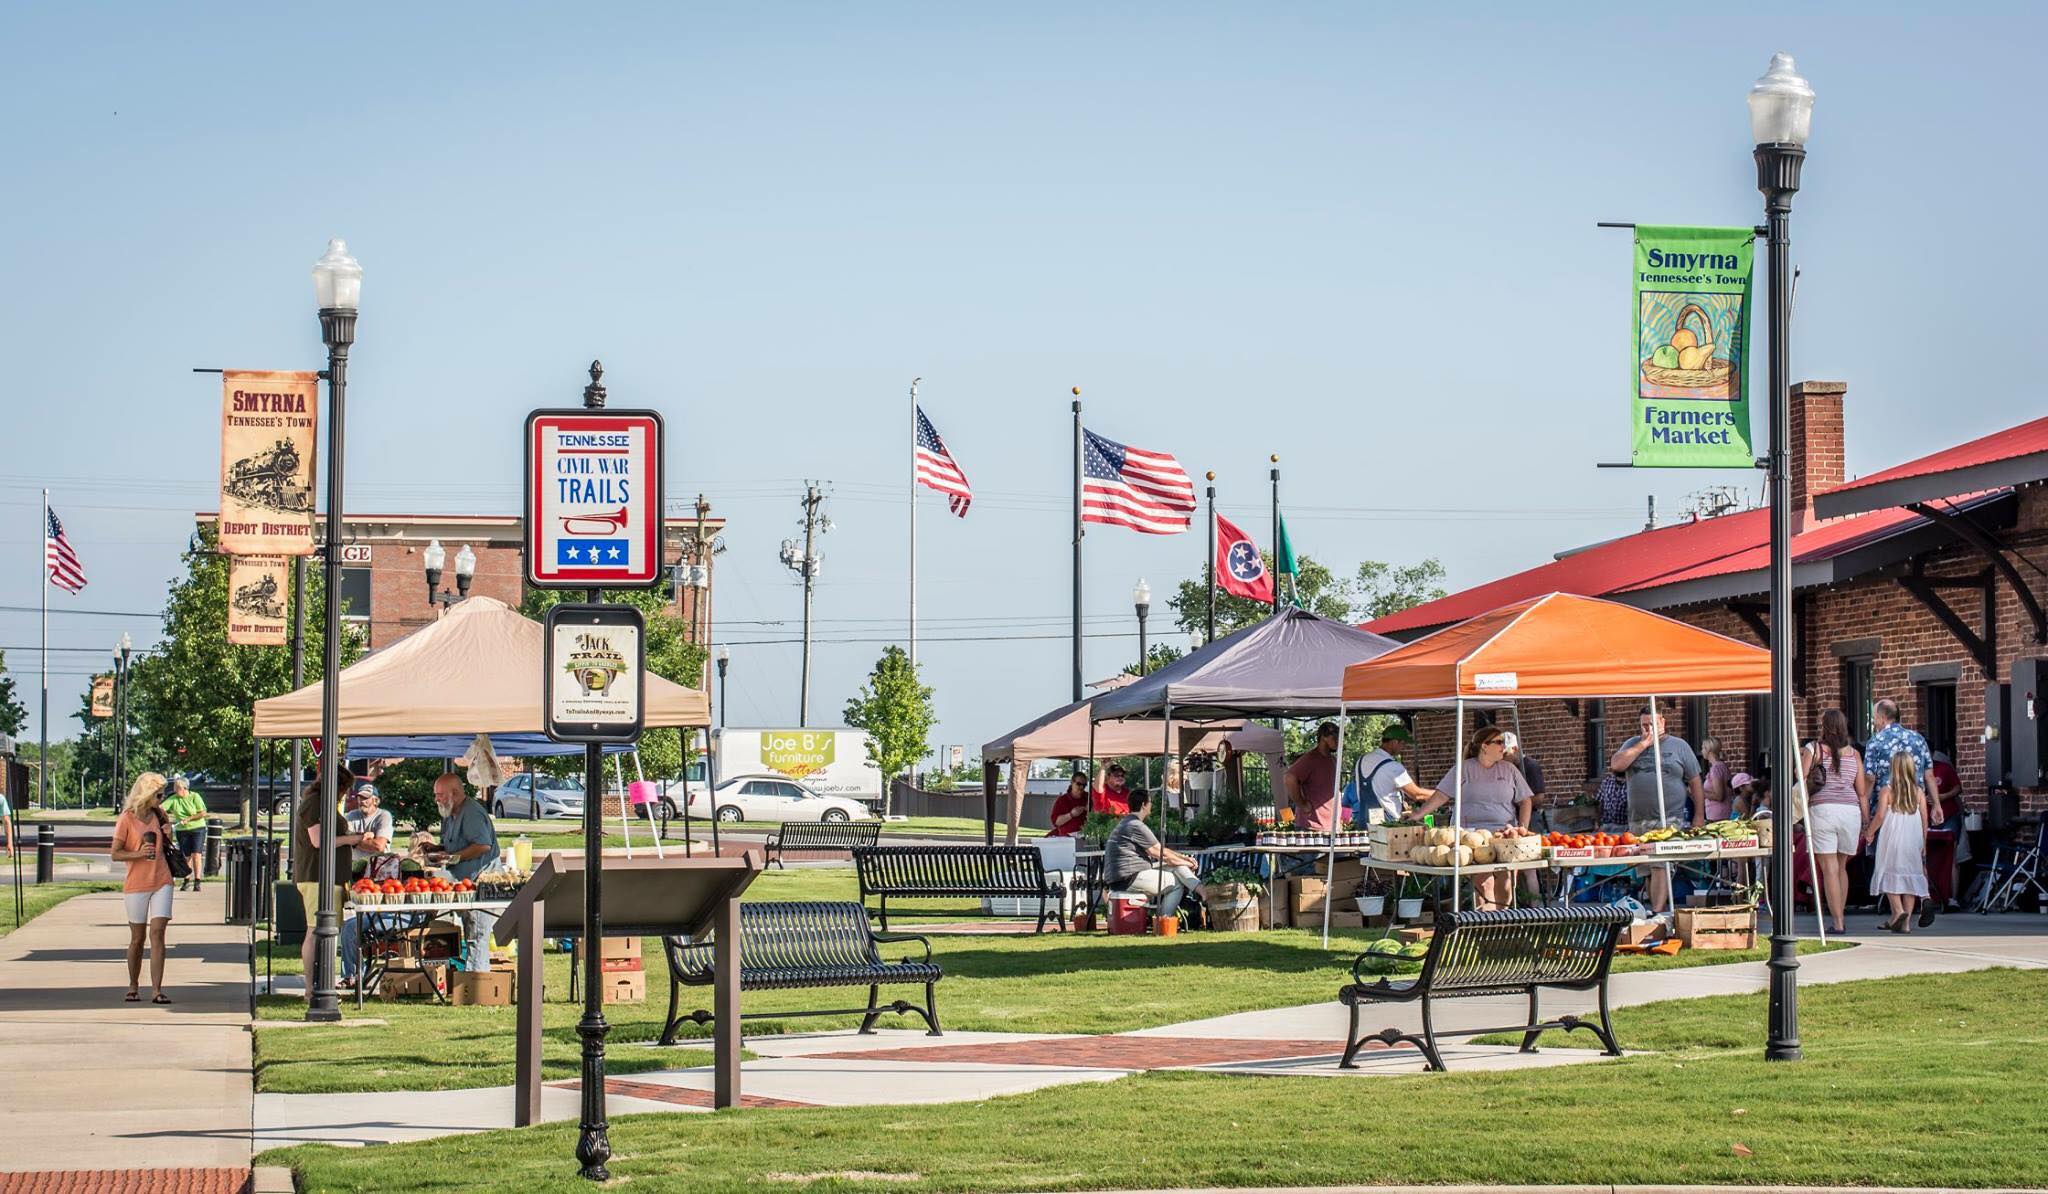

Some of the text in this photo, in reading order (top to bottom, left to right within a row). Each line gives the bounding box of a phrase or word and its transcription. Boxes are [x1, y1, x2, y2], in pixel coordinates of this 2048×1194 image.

[1647, 248, 1738, 272] Smyrna
[1639, 272, 1747, 285] Tennessee's Town
[232, 390, 307, 413] SMYRNA
[227, 415, 313, 428] TENNESSEE'S TOWN
[1645, 406, 1736, 426] Farmers
[558, 434, 630, 447] TENNESSEE
[1651, 427, 1732, 445] Market
[557, 457, 629, 475] CIVIL WAR
[558, 478, 630, 504] TRAILS
[223, 521, 311, 536] DEPOT DISTRICT
[231, 623, 284, 633] DEPOT DISTRICT
[580, 634, 610, 651] JACK
[570, 652, 622, 660] TRAIL
[762, 733, 832, 751] Joe B's
[770, 751, 825, 764] furniture
[777, 763, 828, 776] mattress
